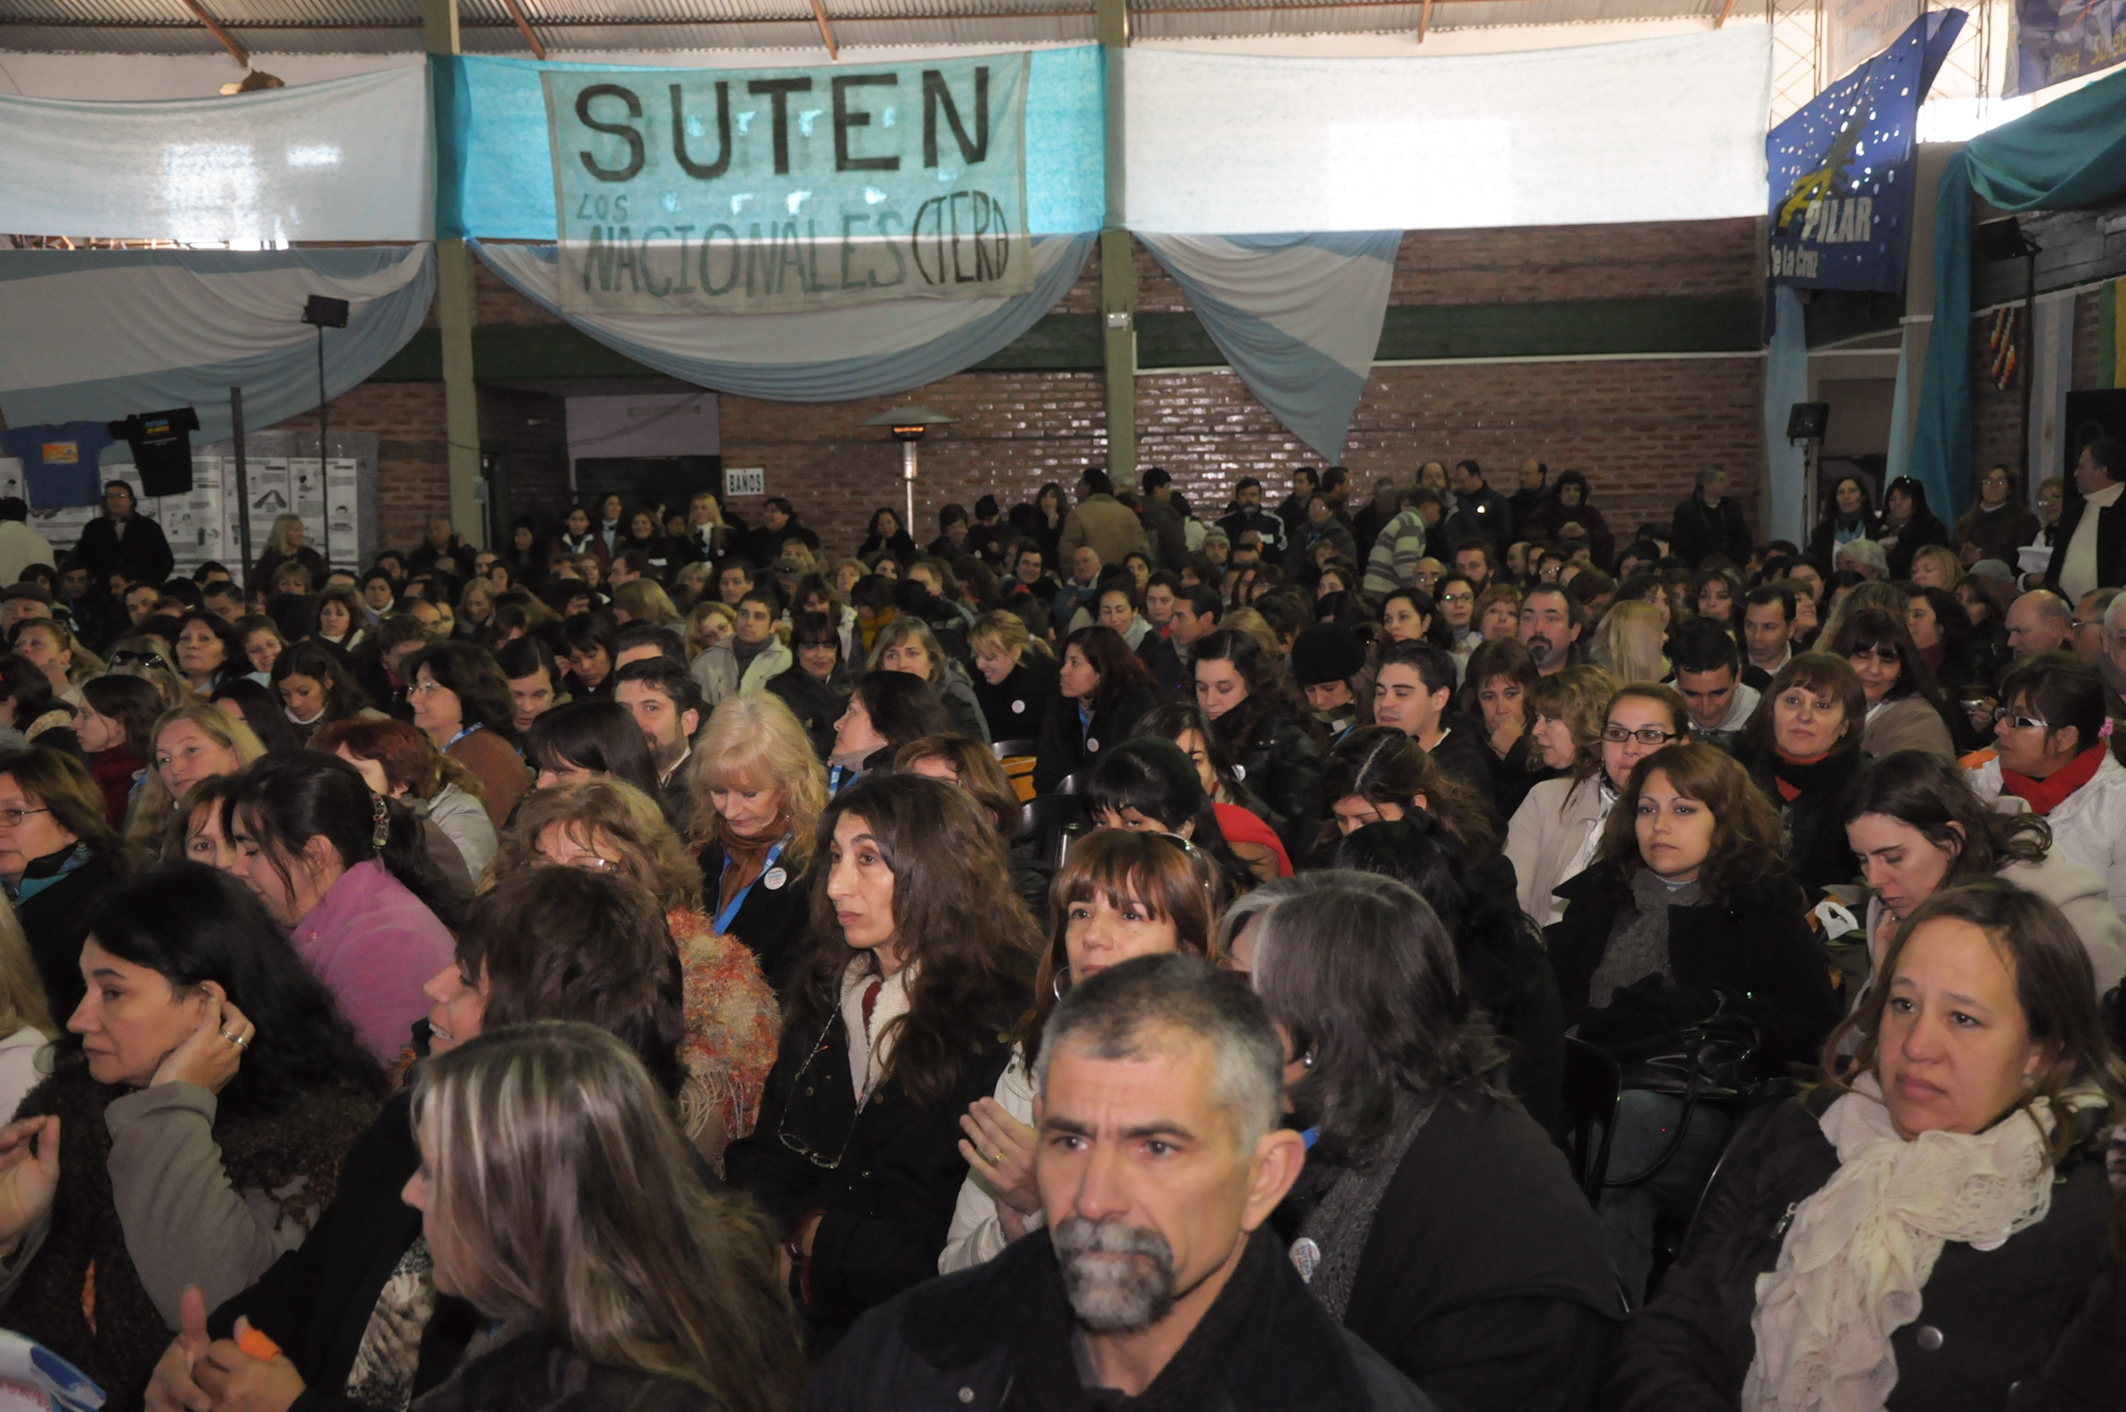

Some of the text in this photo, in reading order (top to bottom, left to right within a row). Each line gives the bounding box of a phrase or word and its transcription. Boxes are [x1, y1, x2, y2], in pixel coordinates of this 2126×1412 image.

[574, 66, 989, 183] SUTEN
[576, 194, 629, 223] LOS
[1800, 196, 1873, 244] PILAR
[583, 210, 907, 298] NACIONALES
[729, 470, 761, 493] BAÑOS
